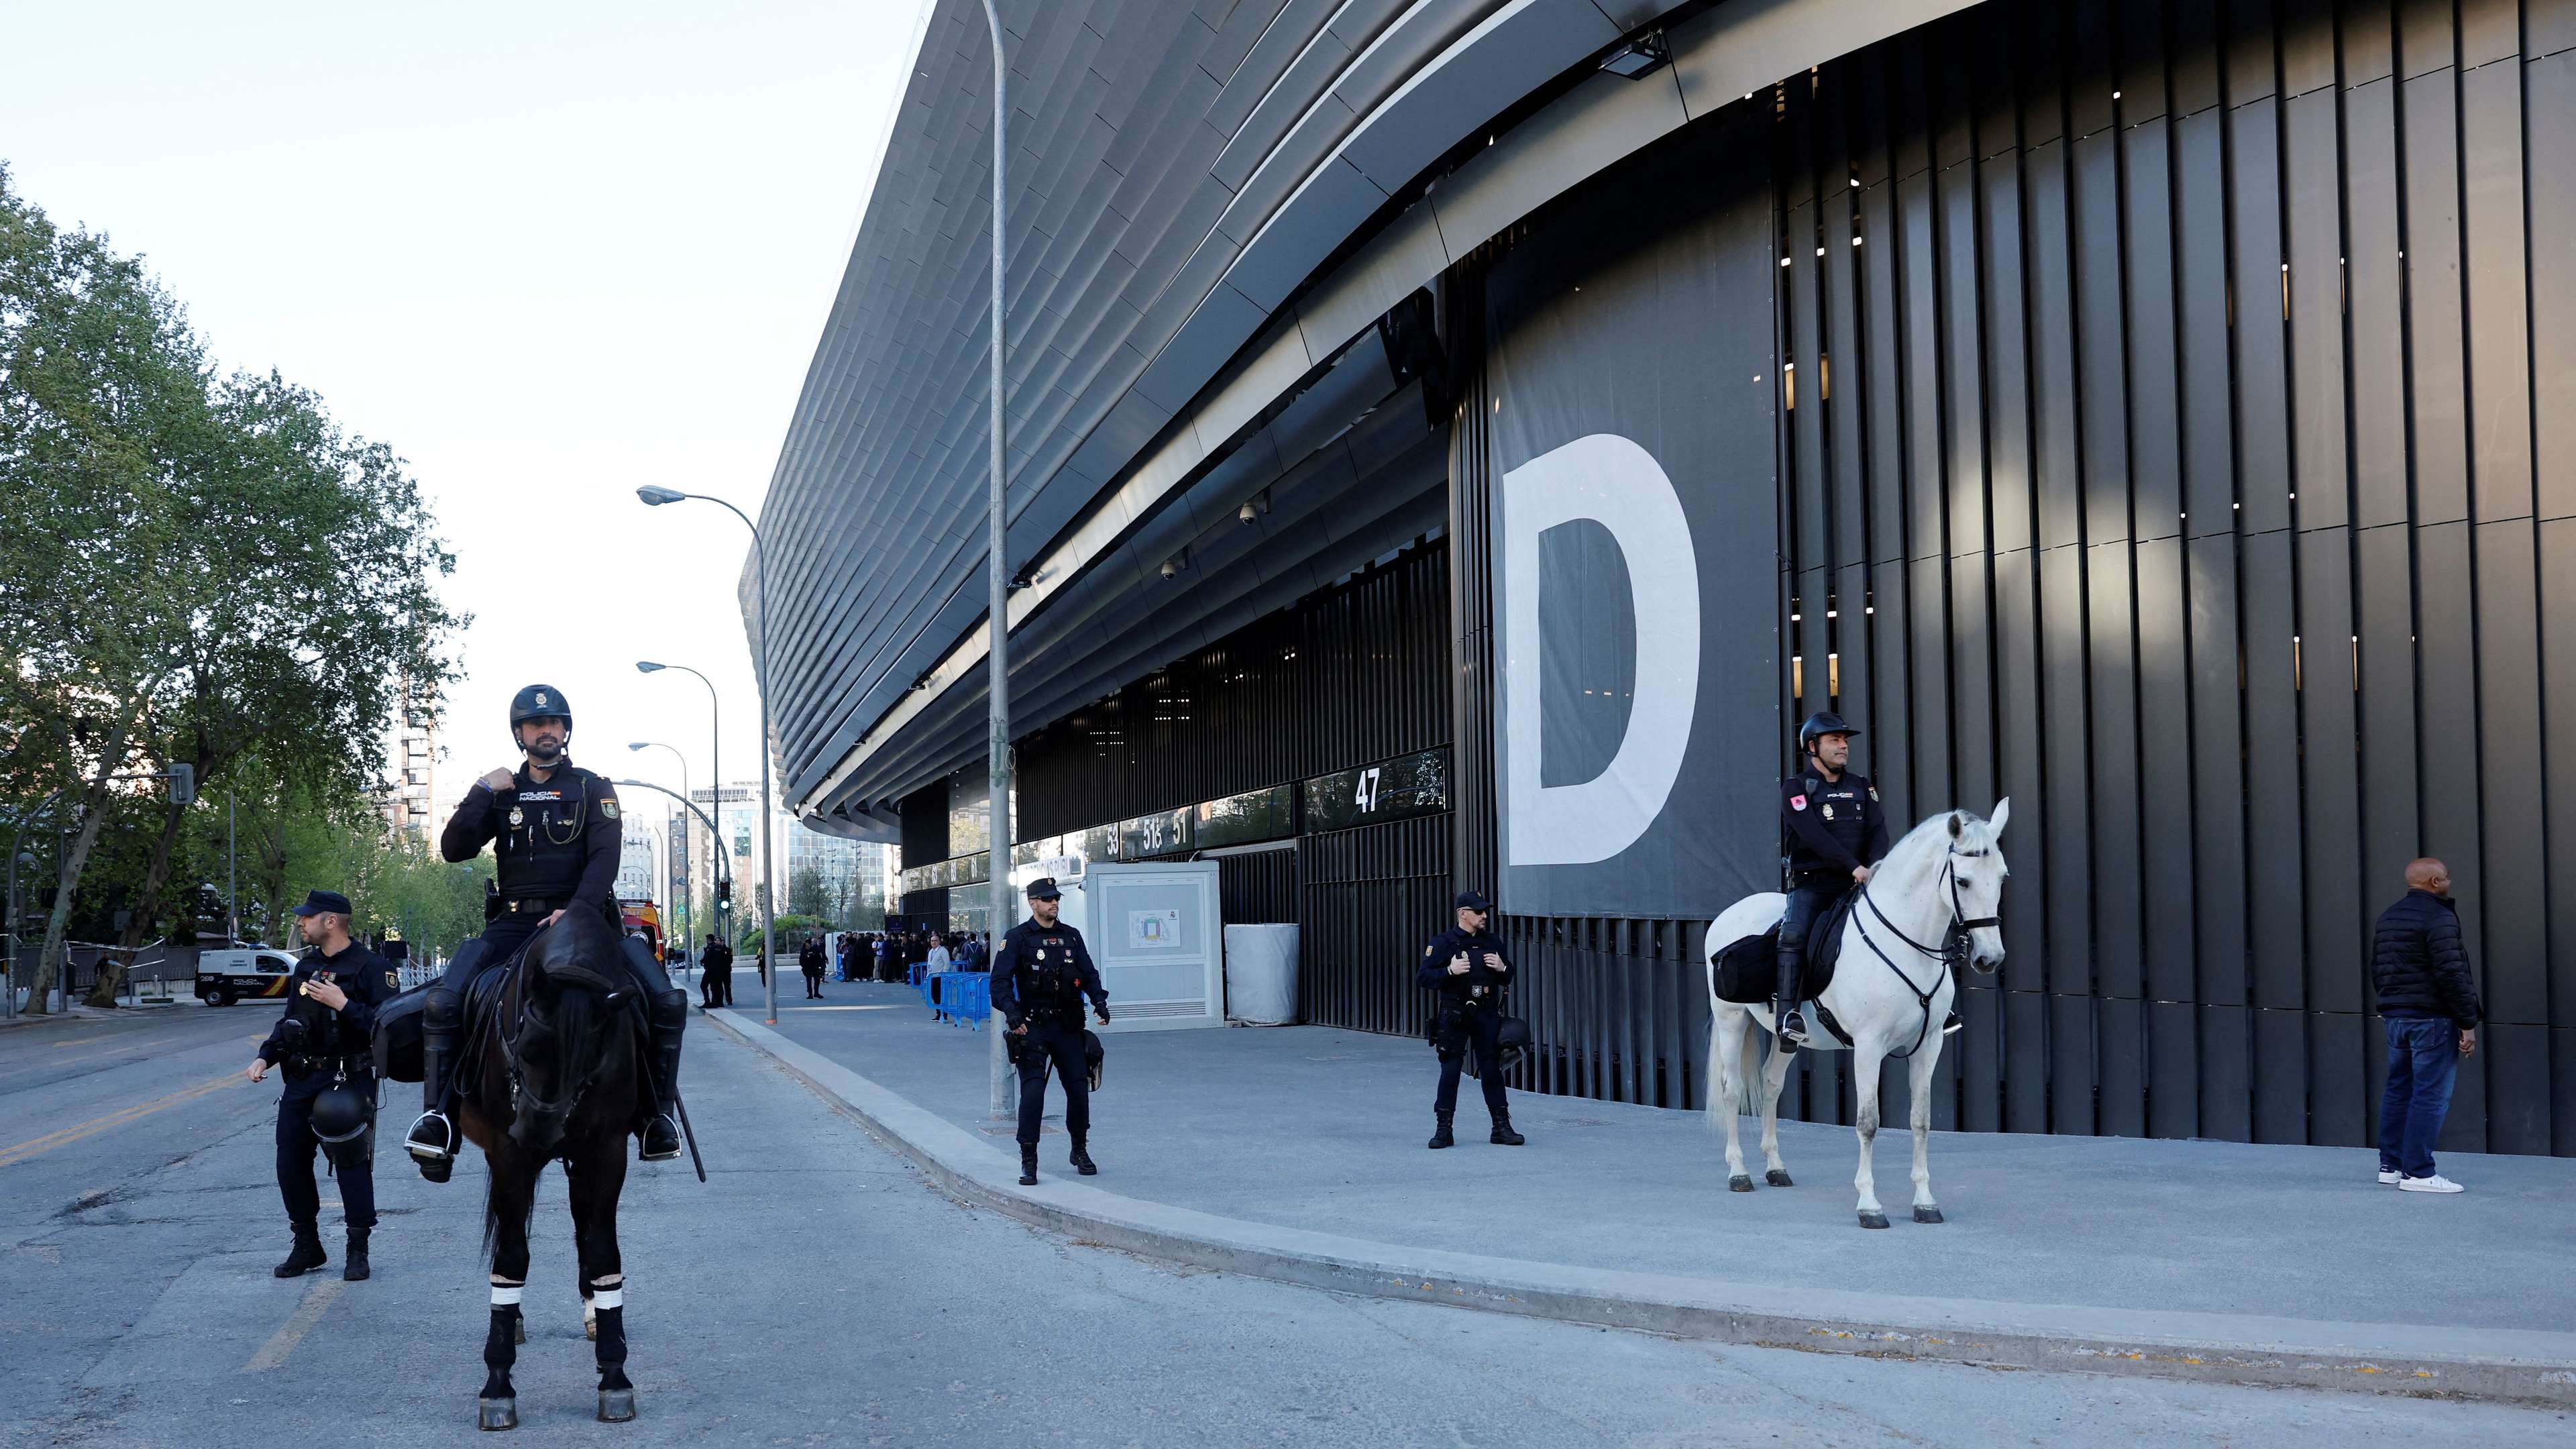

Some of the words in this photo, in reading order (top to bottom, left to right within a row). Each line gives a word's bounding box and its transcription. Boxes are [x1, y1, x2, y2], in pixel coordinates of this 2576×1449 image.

[1503, 433, 1700, 865] D
[1355, 767, 1380, 813] 47
[1107, 826, 1119, 855] 53
[1143, 818, 1155, 851] 51
[1173, 812, 1186, 845] 51
